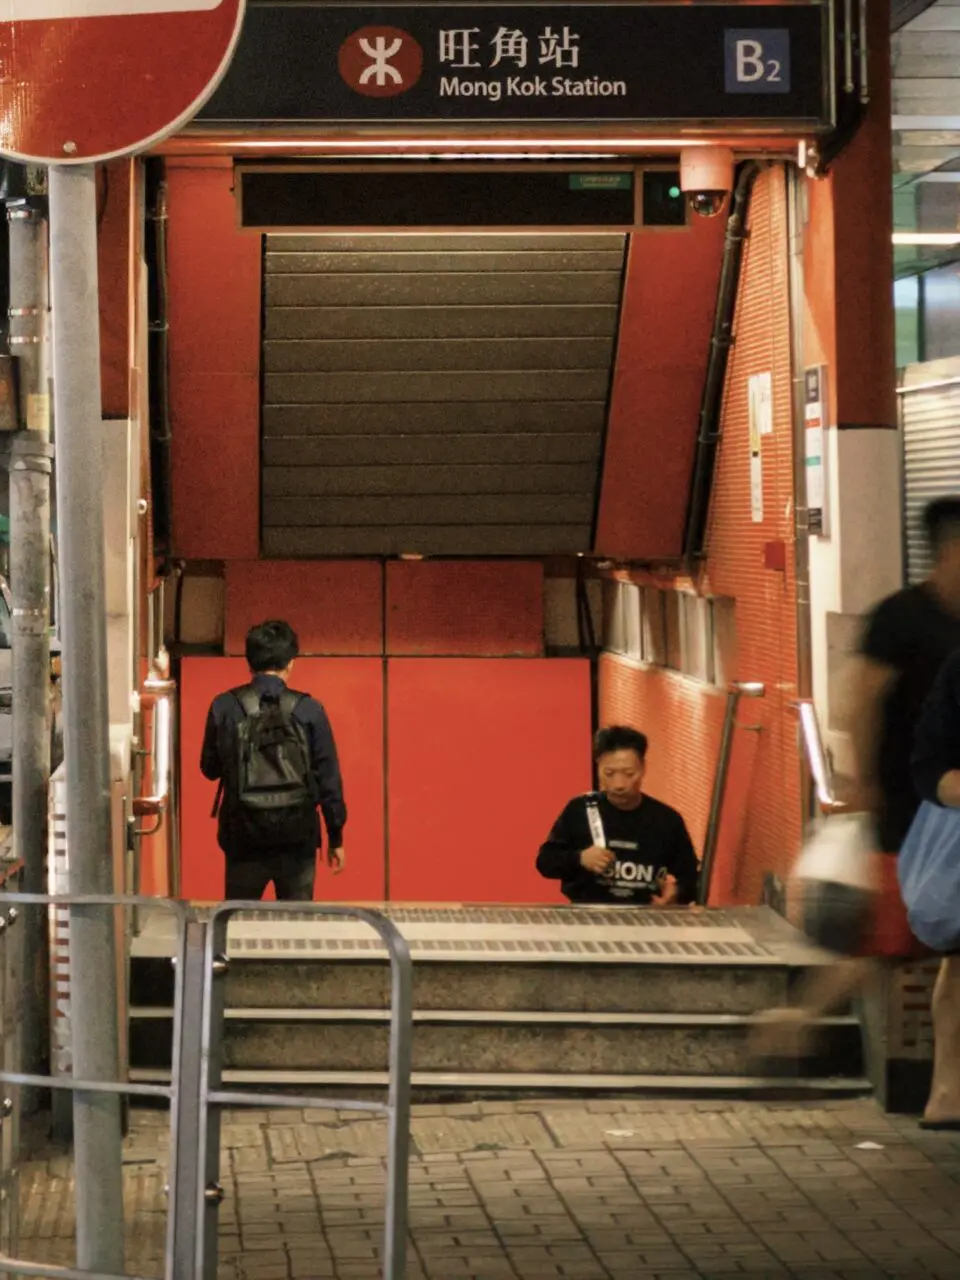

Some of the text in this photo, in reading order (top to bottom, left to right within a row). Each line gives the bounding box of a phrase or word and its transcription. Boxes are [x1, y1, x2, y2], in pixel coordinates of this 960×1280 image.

[439, 26, 581, 69] 旺角站
[737, 39, 781, 83] B2
[440, 75, 627, 101] Mong Kok Station
